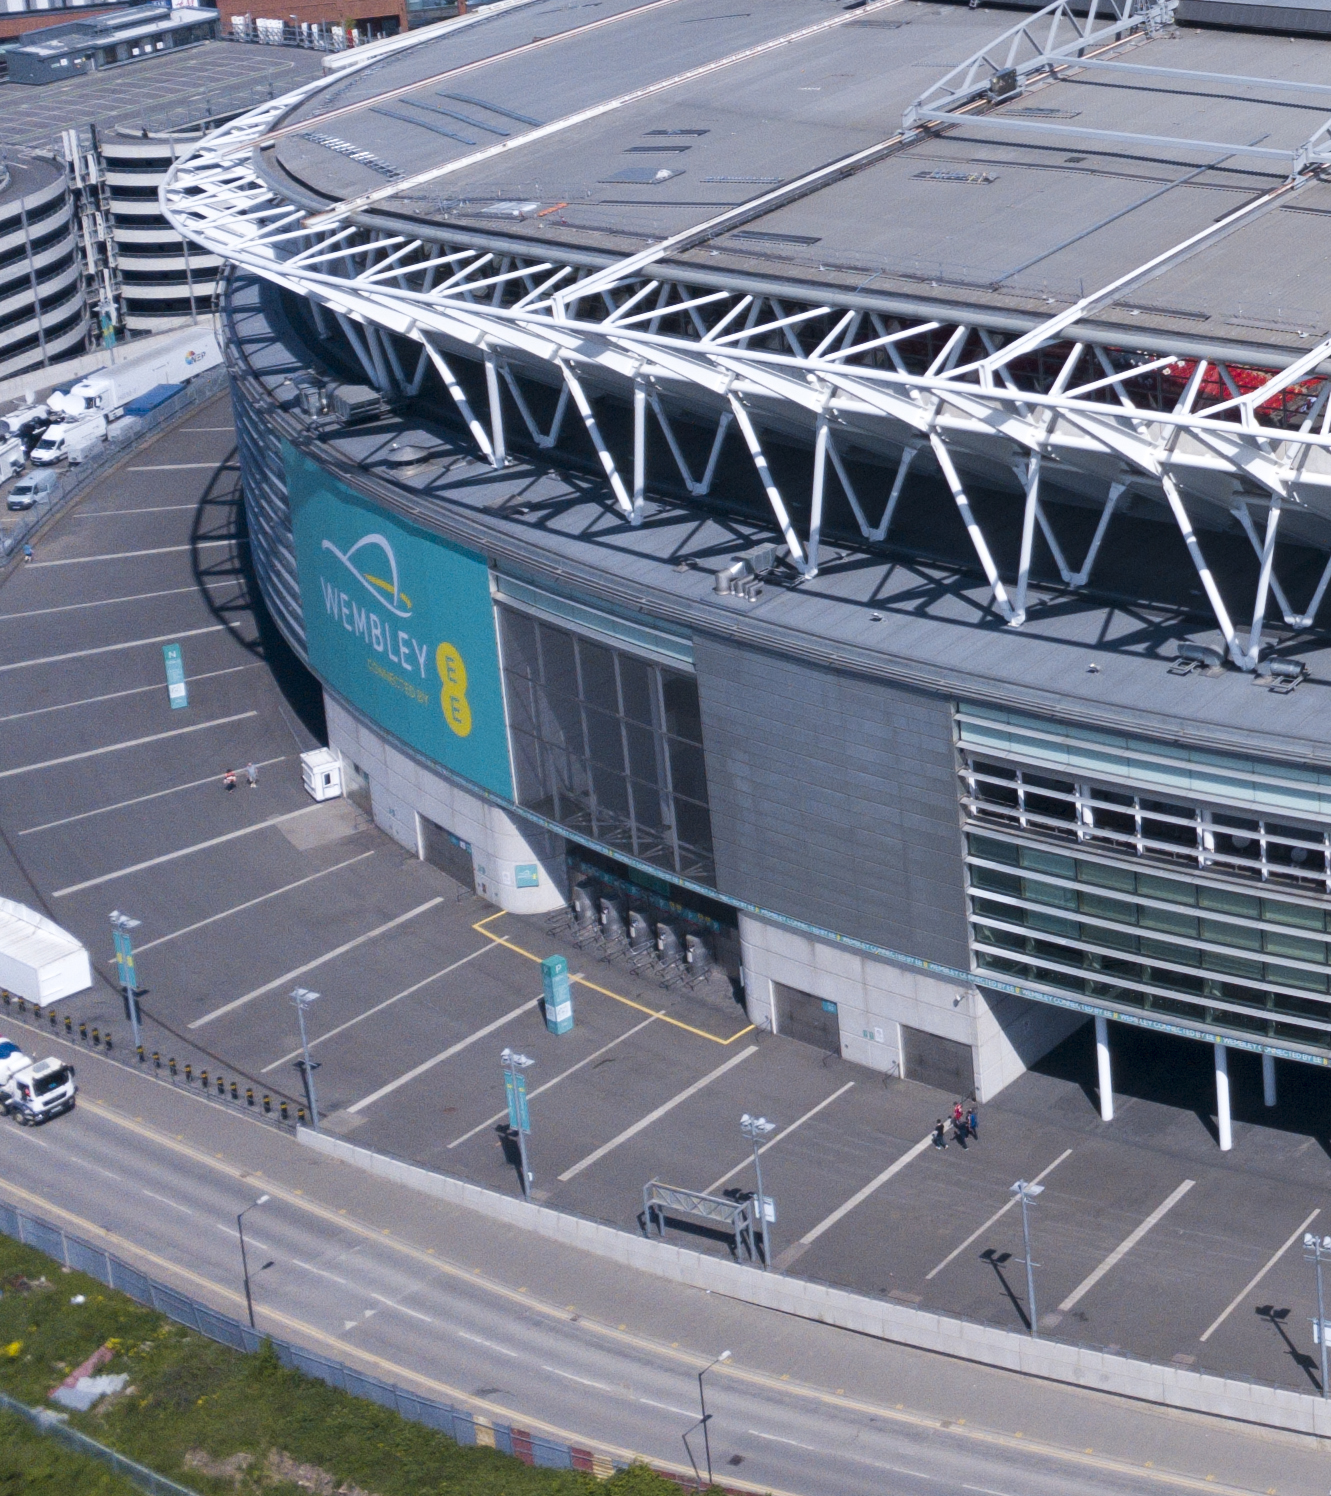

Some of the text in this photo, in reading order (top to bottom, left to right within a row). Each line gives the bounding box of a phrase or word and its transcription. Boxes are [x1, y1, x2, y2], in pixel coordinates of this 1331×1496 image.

[320, 575, 427, 679] WEMBLEY
[168, 650, 177, 659] N
[555, 964, 562, 974] P
[1022, 988, 1113, 1018] WEMBLEY CONNECTED BY EE
[1120, 1013, 1215, 1042] WEMBLEY CONNECTED BY EE
[1222, 1037, 1322, 1064] WEMBLEY CONNECTED BY EE
